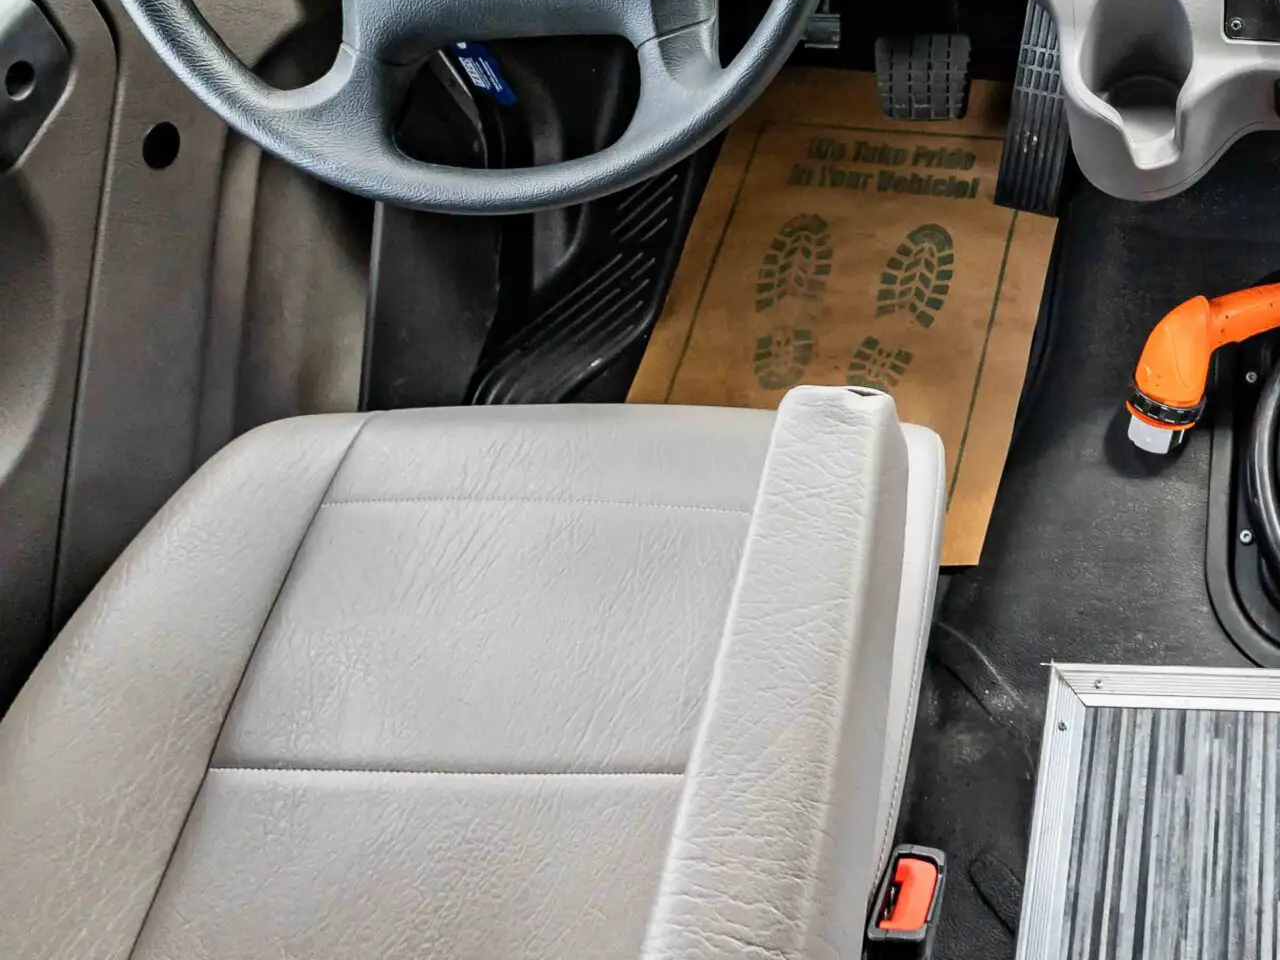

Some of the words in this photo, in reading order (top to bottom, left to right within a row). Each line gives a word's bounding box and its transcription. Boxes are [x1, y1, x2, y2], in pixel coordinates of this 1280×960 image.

[852, 141, 907, 165] Take
[911, 146, 976, 171] Pride
[818, 166, 873, 190] Your
